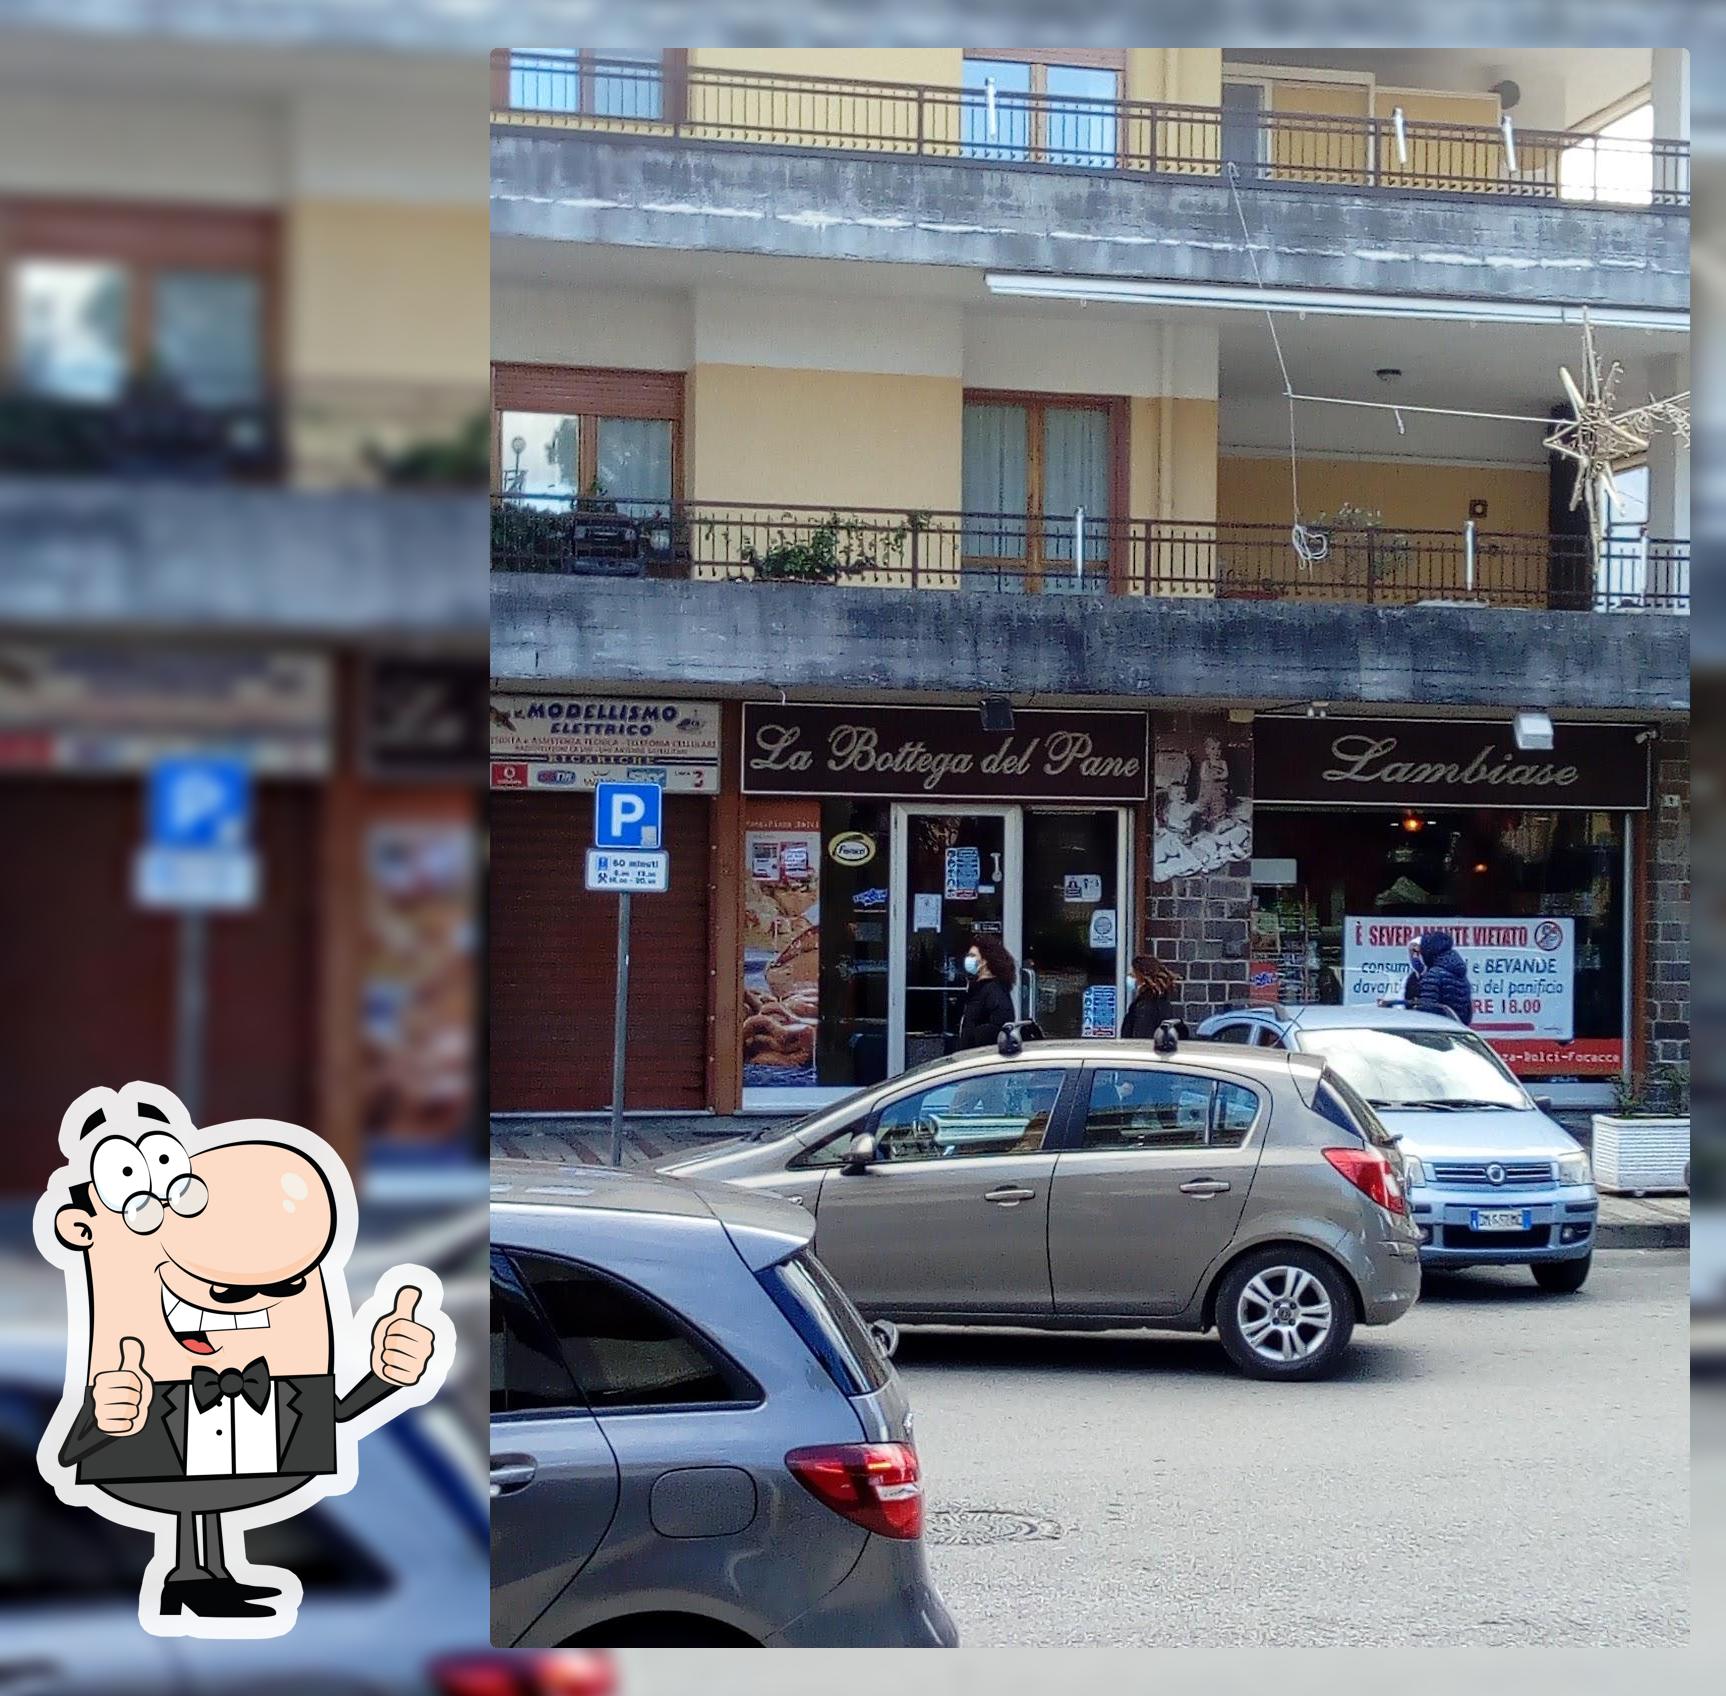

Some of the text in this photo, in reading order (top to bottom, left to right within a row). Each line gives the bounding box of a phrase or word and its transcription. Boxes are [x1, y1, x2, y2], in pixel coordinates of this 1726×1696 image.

[527, 702, 679, 722] MODELLISMO
[550, 722, 654, 736] ELETTRICO
[549, 753, 656, 765] RICARICHE
[750, 724, 1140, 790] La Bottega del Pane
[1322, 734, 1579, 786] Lambiase
[611, 793, 645, 837] P
[612, 859, 626, 867] 60
[628, 860, 659, 868] minuti
[1355, 921, 1363, 946] È
[1473, 926, 1528, 947] VIETATO
[1361, 962, 1411, 974] consum
[1472, 963, 1480, 974] e
[1485, 958, 1558, 974] BEVANDE
[1353, 979, 1403, 994] davant
[1484, 979, 1504, 994] del
[1508, 978, 1563, 998] panificio
[1471, 999, 1541, 1013] RE 18.00
